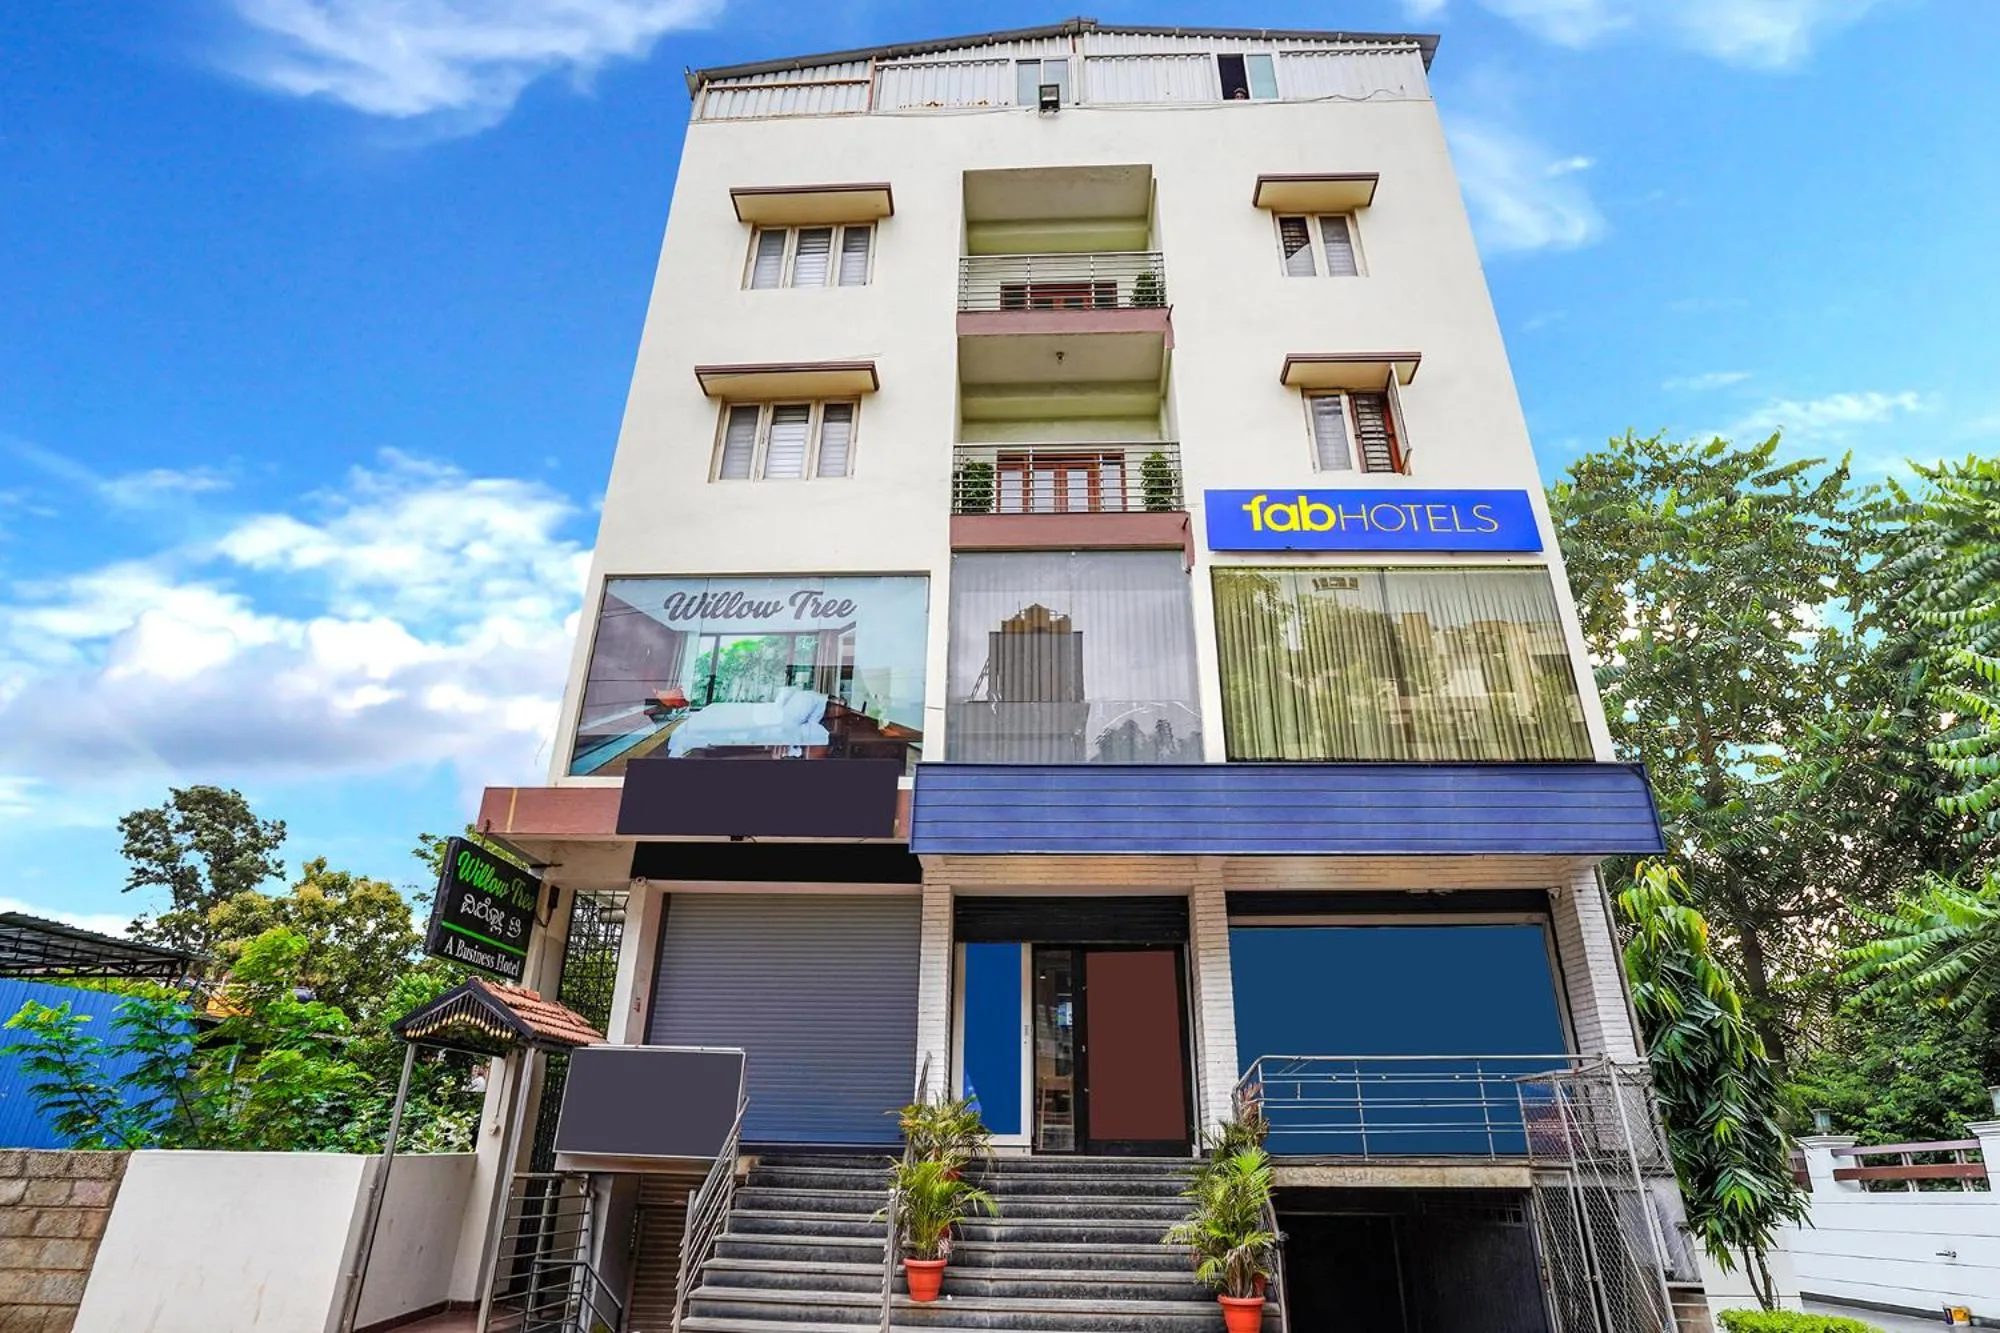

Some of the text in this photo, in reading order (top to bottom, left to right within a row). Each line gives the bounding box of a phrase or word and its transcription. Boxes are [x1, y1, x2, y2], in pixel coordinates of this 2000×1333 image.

[663, 589, 857, 622] Willow Tree
[457, 851, 536, 912] Willow Tree
[444, 935, 520, 976] A Business Hotel
